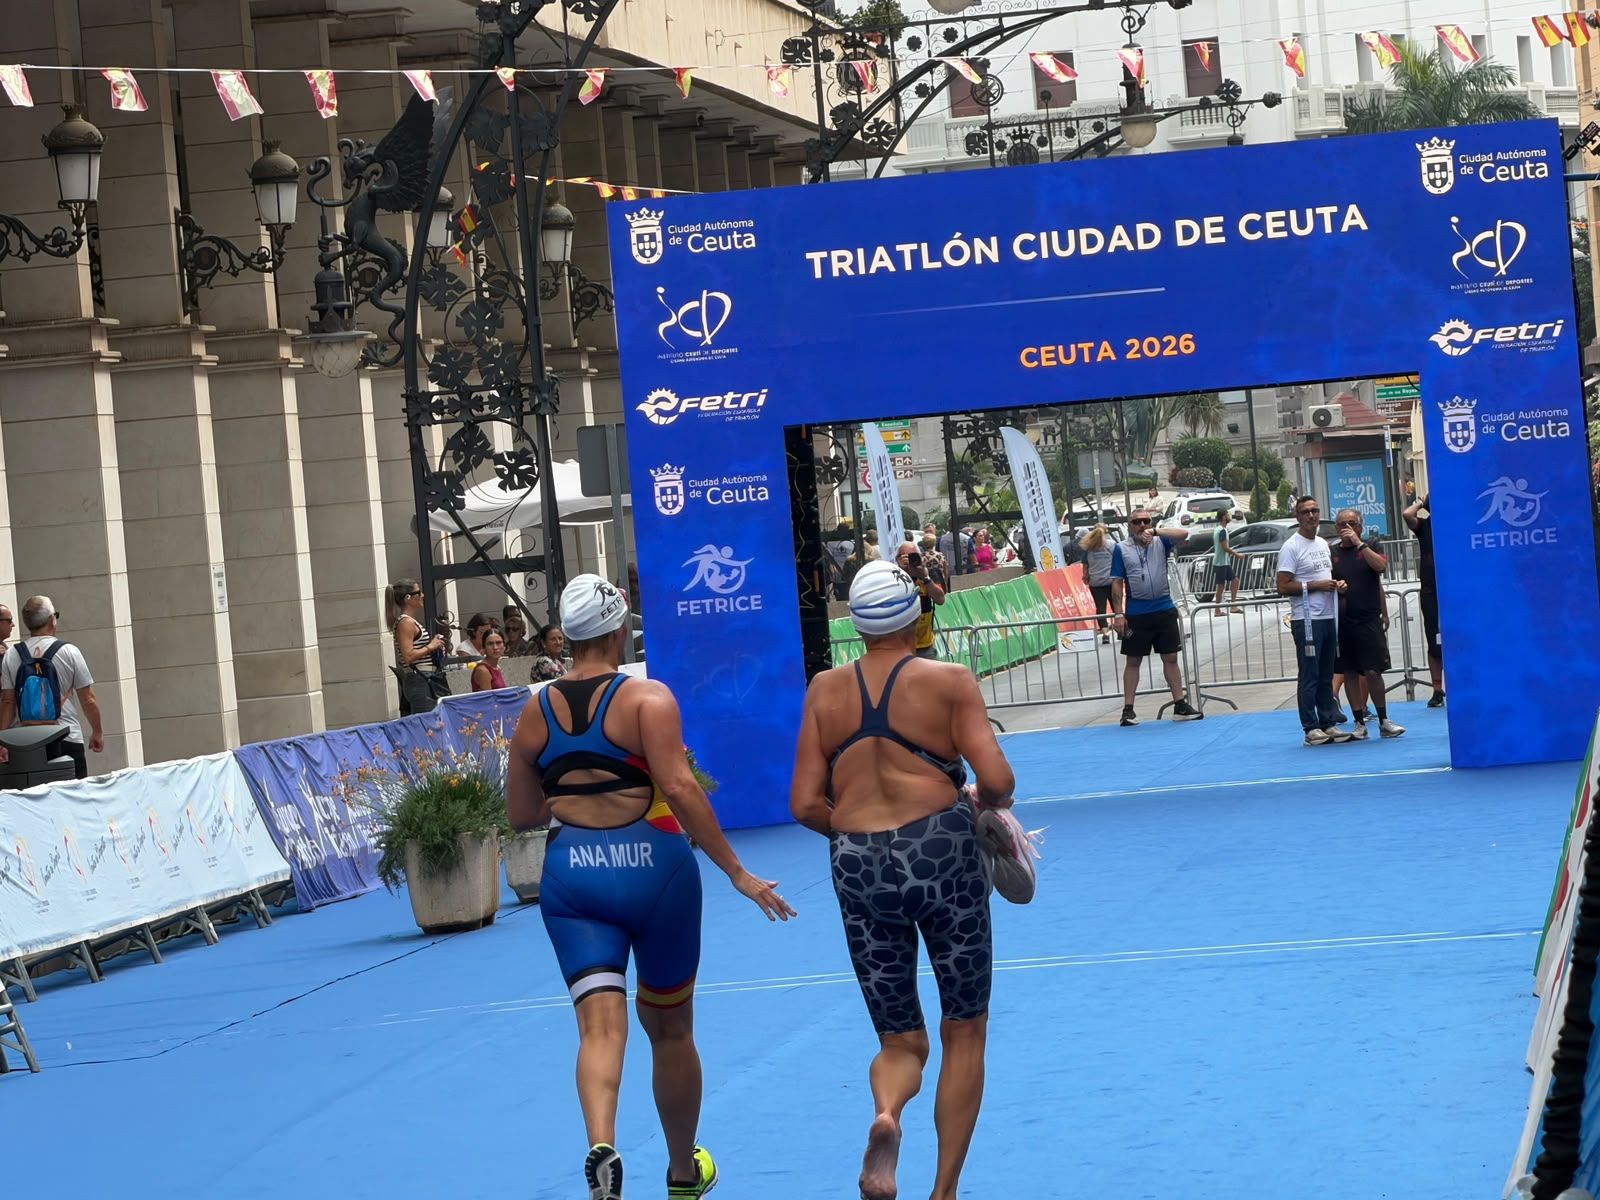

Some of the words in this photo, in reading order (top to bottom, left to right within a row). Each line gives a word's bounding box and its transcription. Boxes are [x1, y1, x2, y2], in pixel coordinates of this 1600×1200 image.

[1459, 152, 1493, 164] Ciudad
[1496, 149, 1547, 160] Autónoma
[1460, 165, 1474, 175] de
[1478, 160, 1549, 183] Ceuta
[667, 223, 701, 234] Ciudad
[704, 219, 754, 231] Autónoma
[668, 235, 682, 245] de
[687, 231, 756, 253] Ceuta
[805, 231, 999, 280] TRIATLÓN
[1012, 221, 1162, 261] CIUDAD
[1175, 216, 1226, 247] DE
[1237, 203, 1369, 241] CEUTA
[1019, 340, 1117, 369] CEUTA
[1124, 333, 1196, 361] 2026
[1481, 411, 1515, 423] Ciudad
[1518, 407, 1569, 419] Autónoma
[1482, 424, 1496, 434] de
[1501, 419, 1570, 442] Ceuta
[688, 477, 719, 488] Ciudad
[721, 474, 767, 485] Autónoma
[689, 488, 702, 498] de
[706, 485, 769, 505] Ceuta
[1356, 483, 1376, 504] 20
[1470, 527, 1558, 550] FETRICE
[676, 594, 762, 616] FETRICE
[569, 844, 610, 869] ANA
[610, 842, 654, 868] MUR
